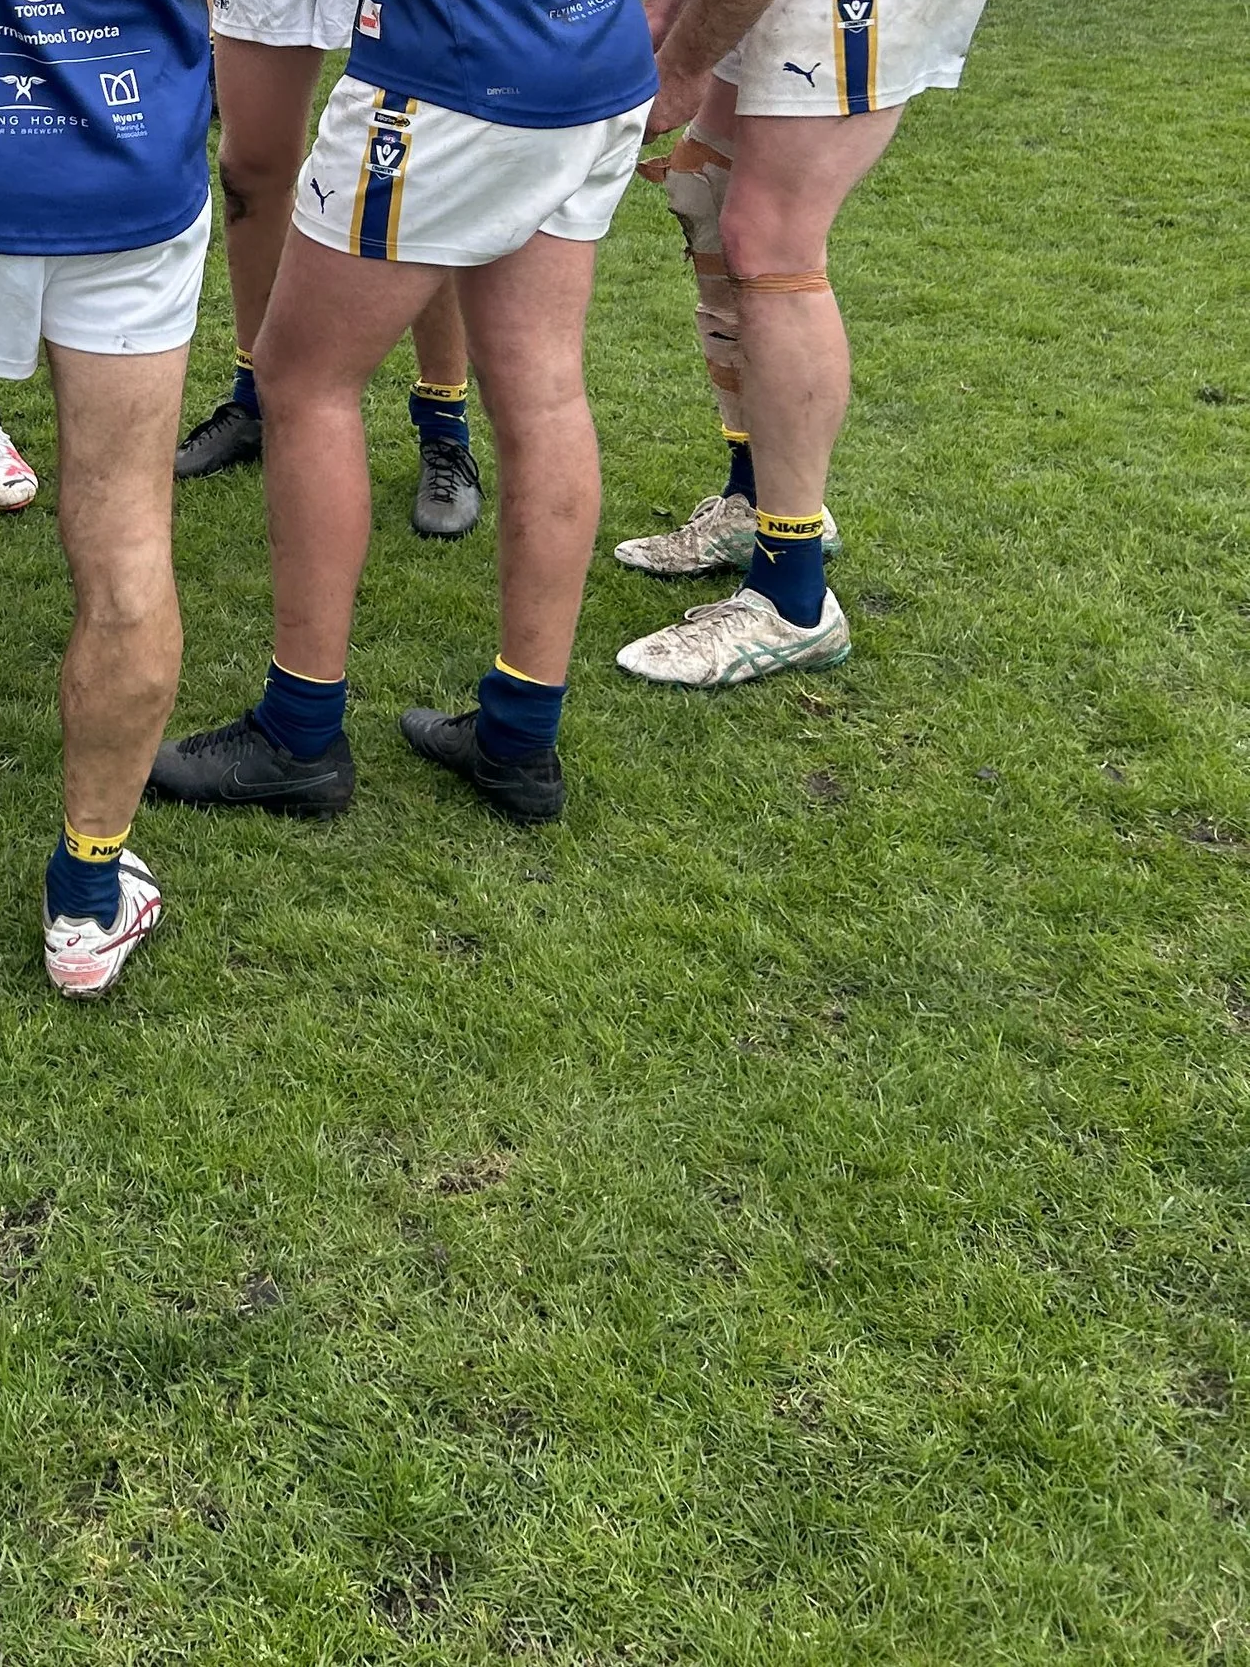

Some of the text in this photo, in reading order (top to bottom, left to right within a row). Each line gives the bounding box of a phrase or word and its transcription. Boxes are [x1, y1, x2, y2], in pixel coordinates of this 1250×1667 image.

[14, 3, 65, 18] TOYOTA
[68, 25, 120, 45] Toyota
[486, 87, 521, 96] DRYCELL
[30, 115, 90, 128] HORSE
[112, 111, 144, 124] Myers
